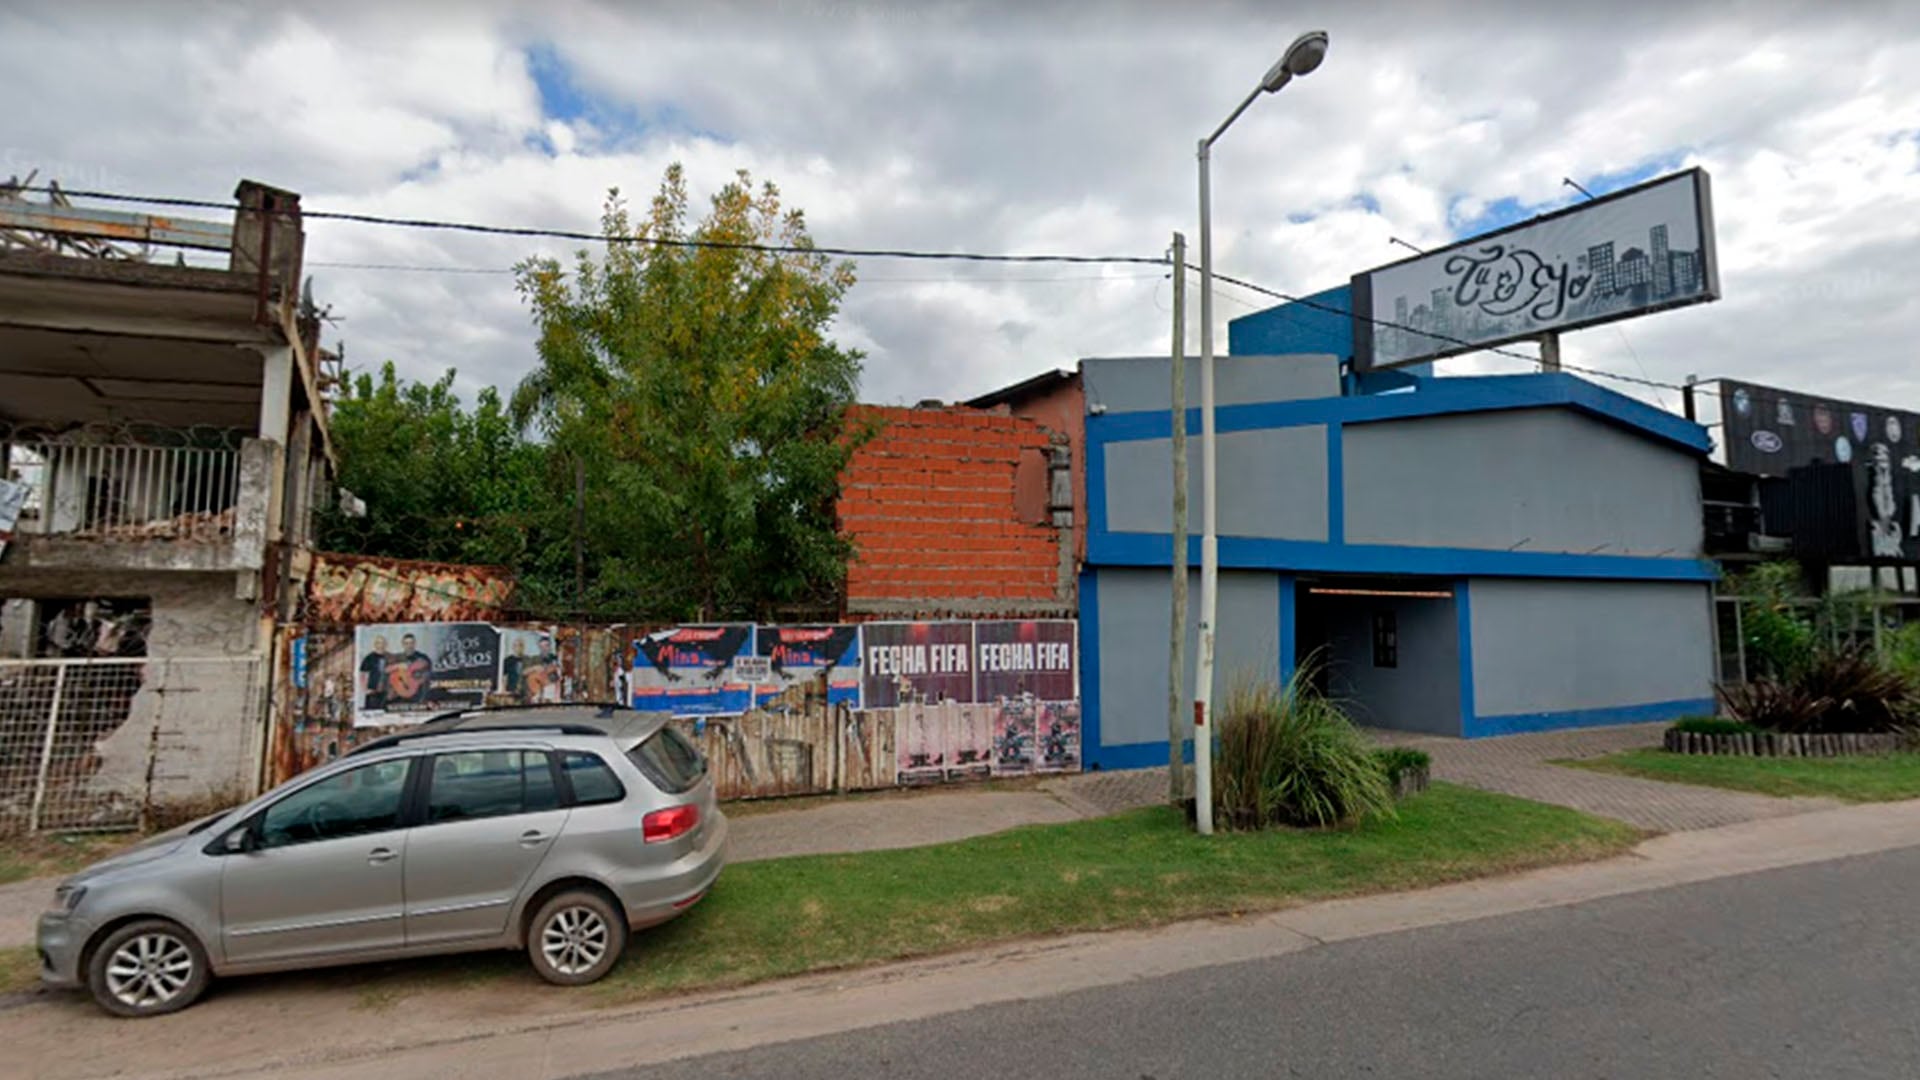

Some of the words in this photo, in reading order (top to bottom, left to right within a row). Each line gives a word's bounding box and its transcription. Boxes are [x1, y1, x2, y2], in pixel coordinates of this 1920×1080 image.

[1445, 244, 1505, 306] Tu
[1531, 263, 1592, 321] Yo
[658, 645, 699, 666] Mina
[771, 645, 810, 665] Mina
[870, 646, 927, 675] FECHA
[931, 644, 968, 672] FIFA
[980, 644, 1034, 672] FECHA
[1037, 643, 1069, 670] FIFA
